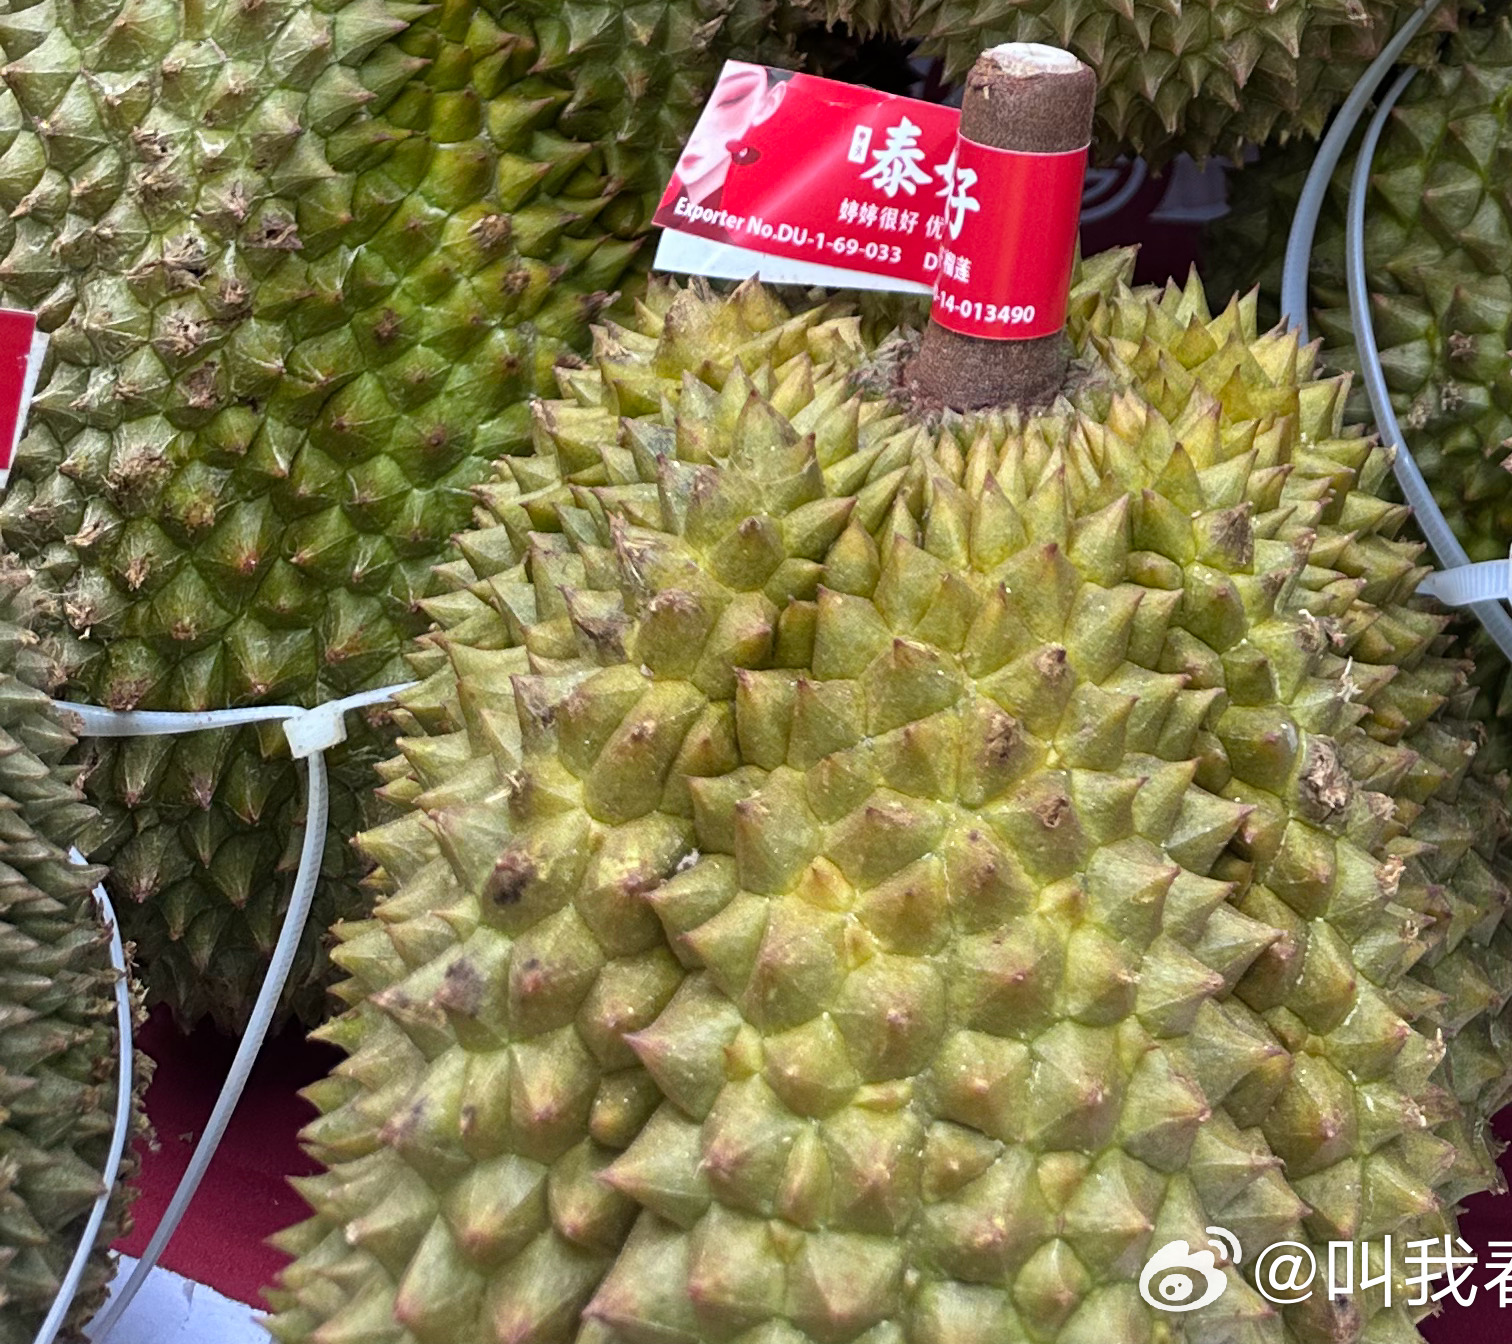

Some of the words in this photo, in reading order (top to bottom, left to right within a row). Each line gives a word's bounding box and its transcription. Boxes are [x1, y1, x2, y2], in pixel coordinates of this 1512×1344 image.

[673, 196, 745, 233] Exporter
[747, 217, 902, 264] No.DU-1-69-033
[838, 196, 920, 236] 婷婷很好
